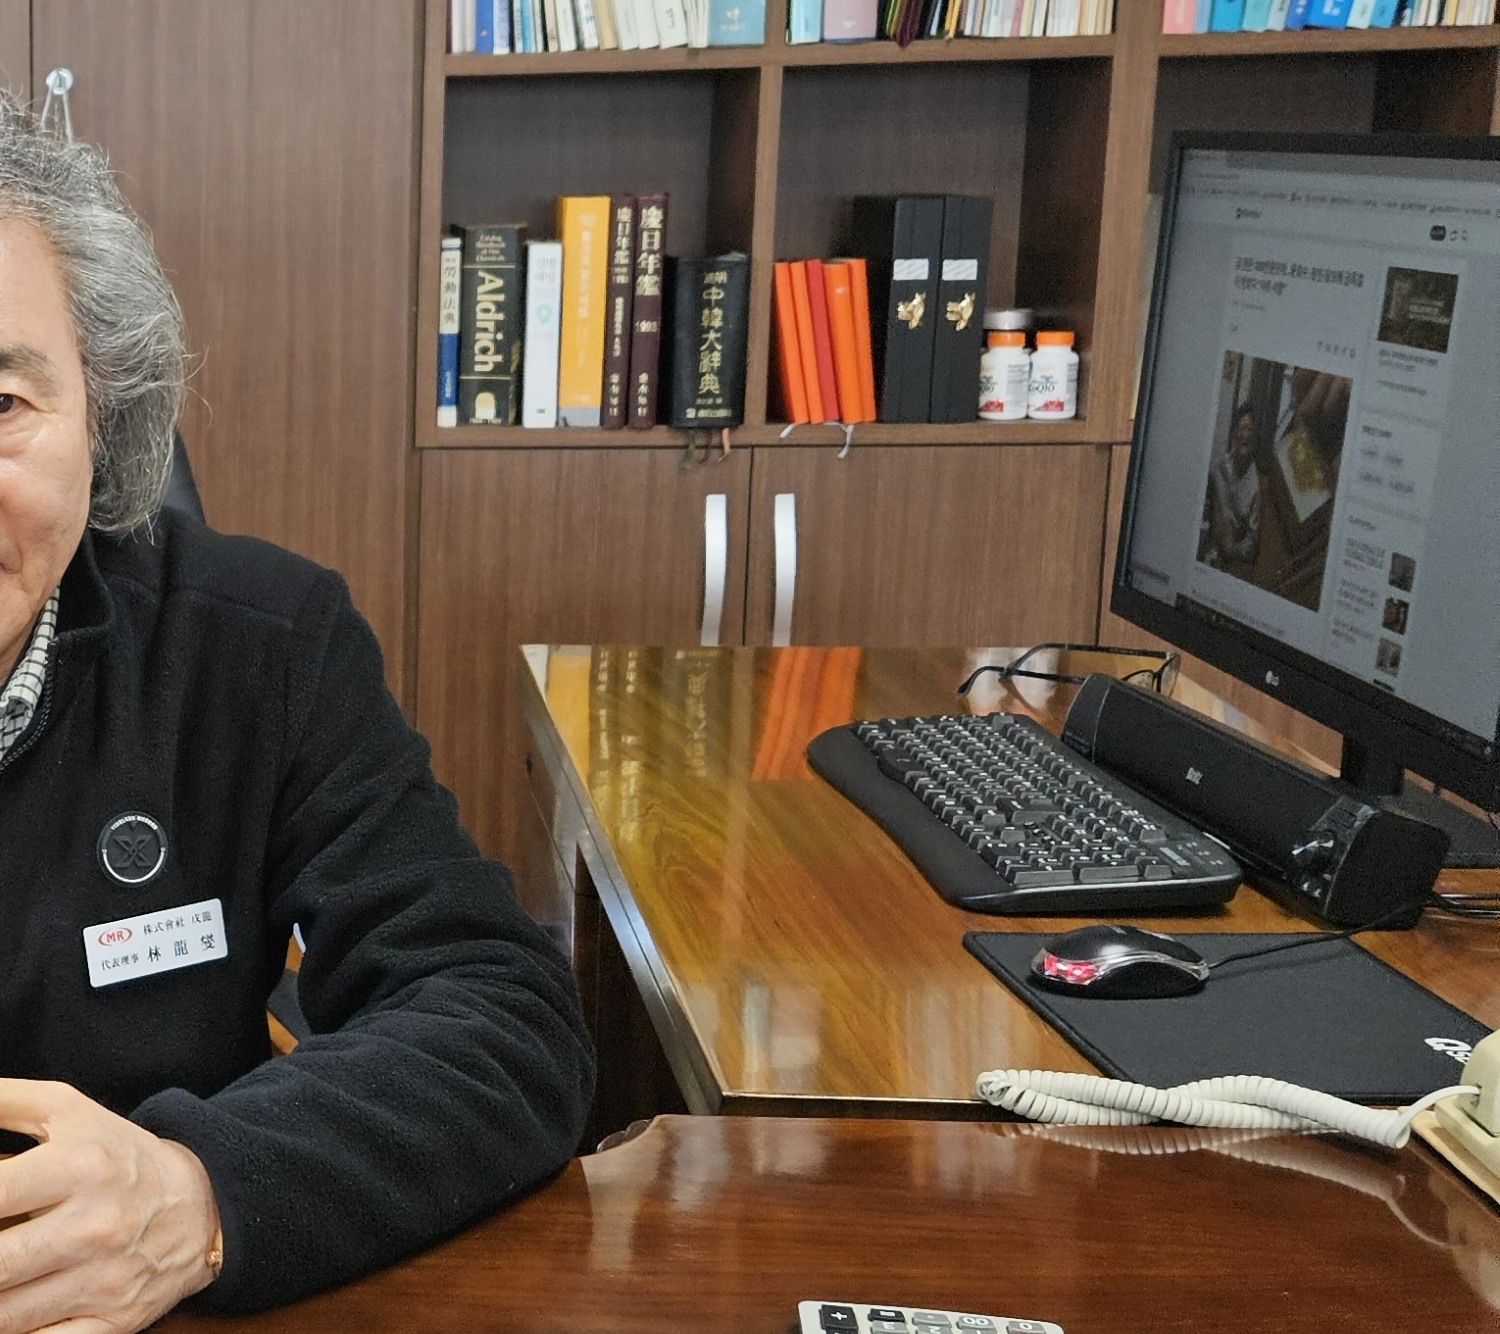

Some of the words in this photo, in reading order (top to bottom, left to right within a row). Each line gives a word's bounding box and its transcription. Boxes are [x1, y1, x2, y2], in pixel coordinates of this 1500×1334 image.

[474, 270, 505, 372] Aldrich
[698, 285, 726, 395] 中韓大辭典
[143, 918, 186, 936] 株式會社
[105, 929, 125, 944] MR
[101, 952, 140, 971] 代表理事
[883, 1321, 895, 1330] 3
[962, 1316, 990, 1326] 00
[1018, 1322, 1034, 1331] 0
[928, 1325, 942, 1334] 2
